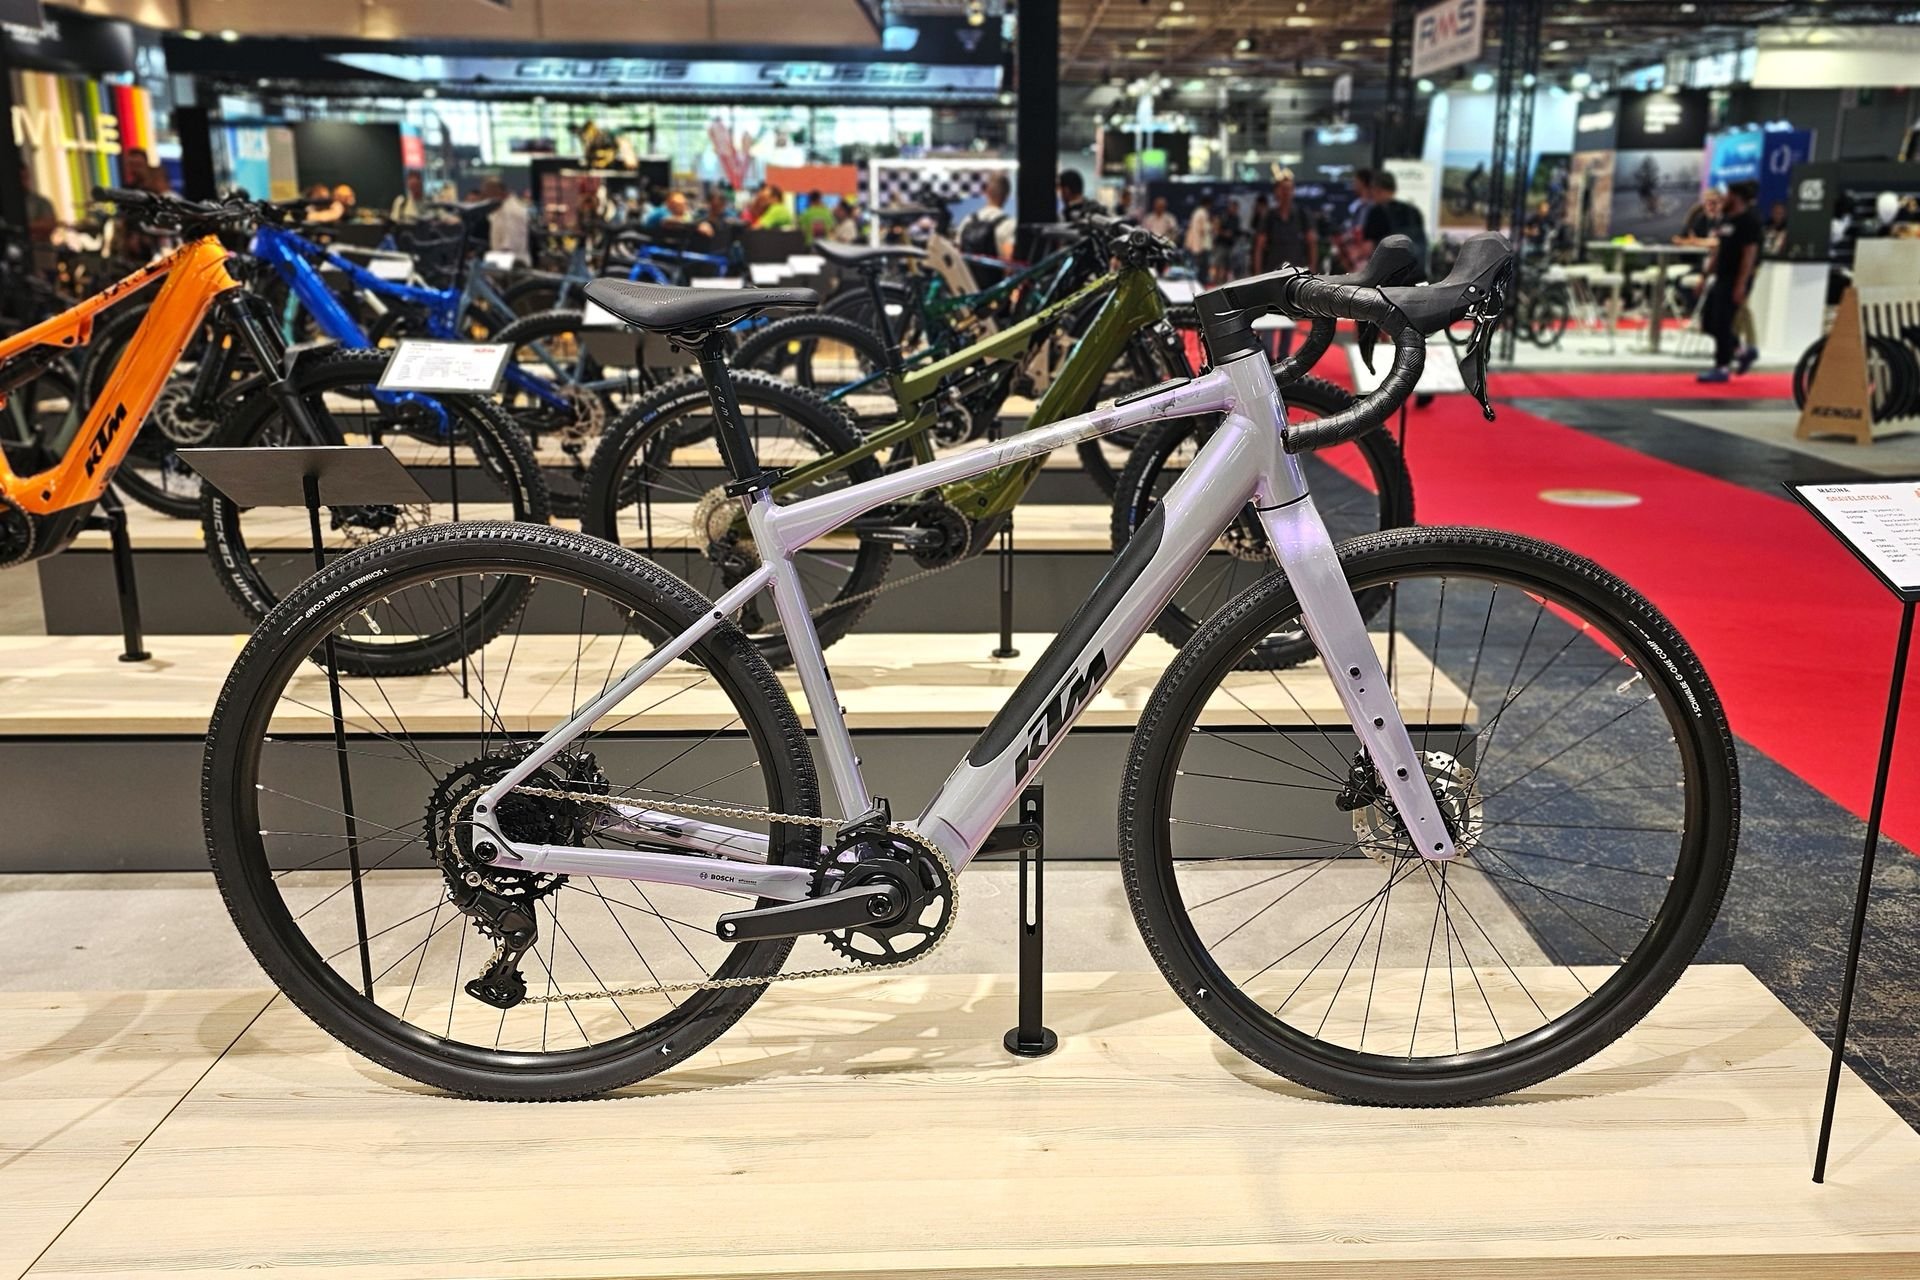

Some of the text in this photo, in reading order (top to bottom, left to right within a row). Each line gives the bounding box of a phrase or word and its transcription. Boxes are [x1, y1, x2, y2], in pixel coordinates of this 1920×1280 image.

[514, 60, 690, 80] CRUSSIS
[85, 402, 127, 479] KTM
[213, 497, 262, 612] WICKED WILL
[305, 569, 384, 619] SCHWALBE G-ONE COMP
[1647, 640, 1702, 713] SCHWALBE G-ONE COMP
[1015, 648, 1108, 787] KTM
[711, 873, 735, 882] BOSCH
